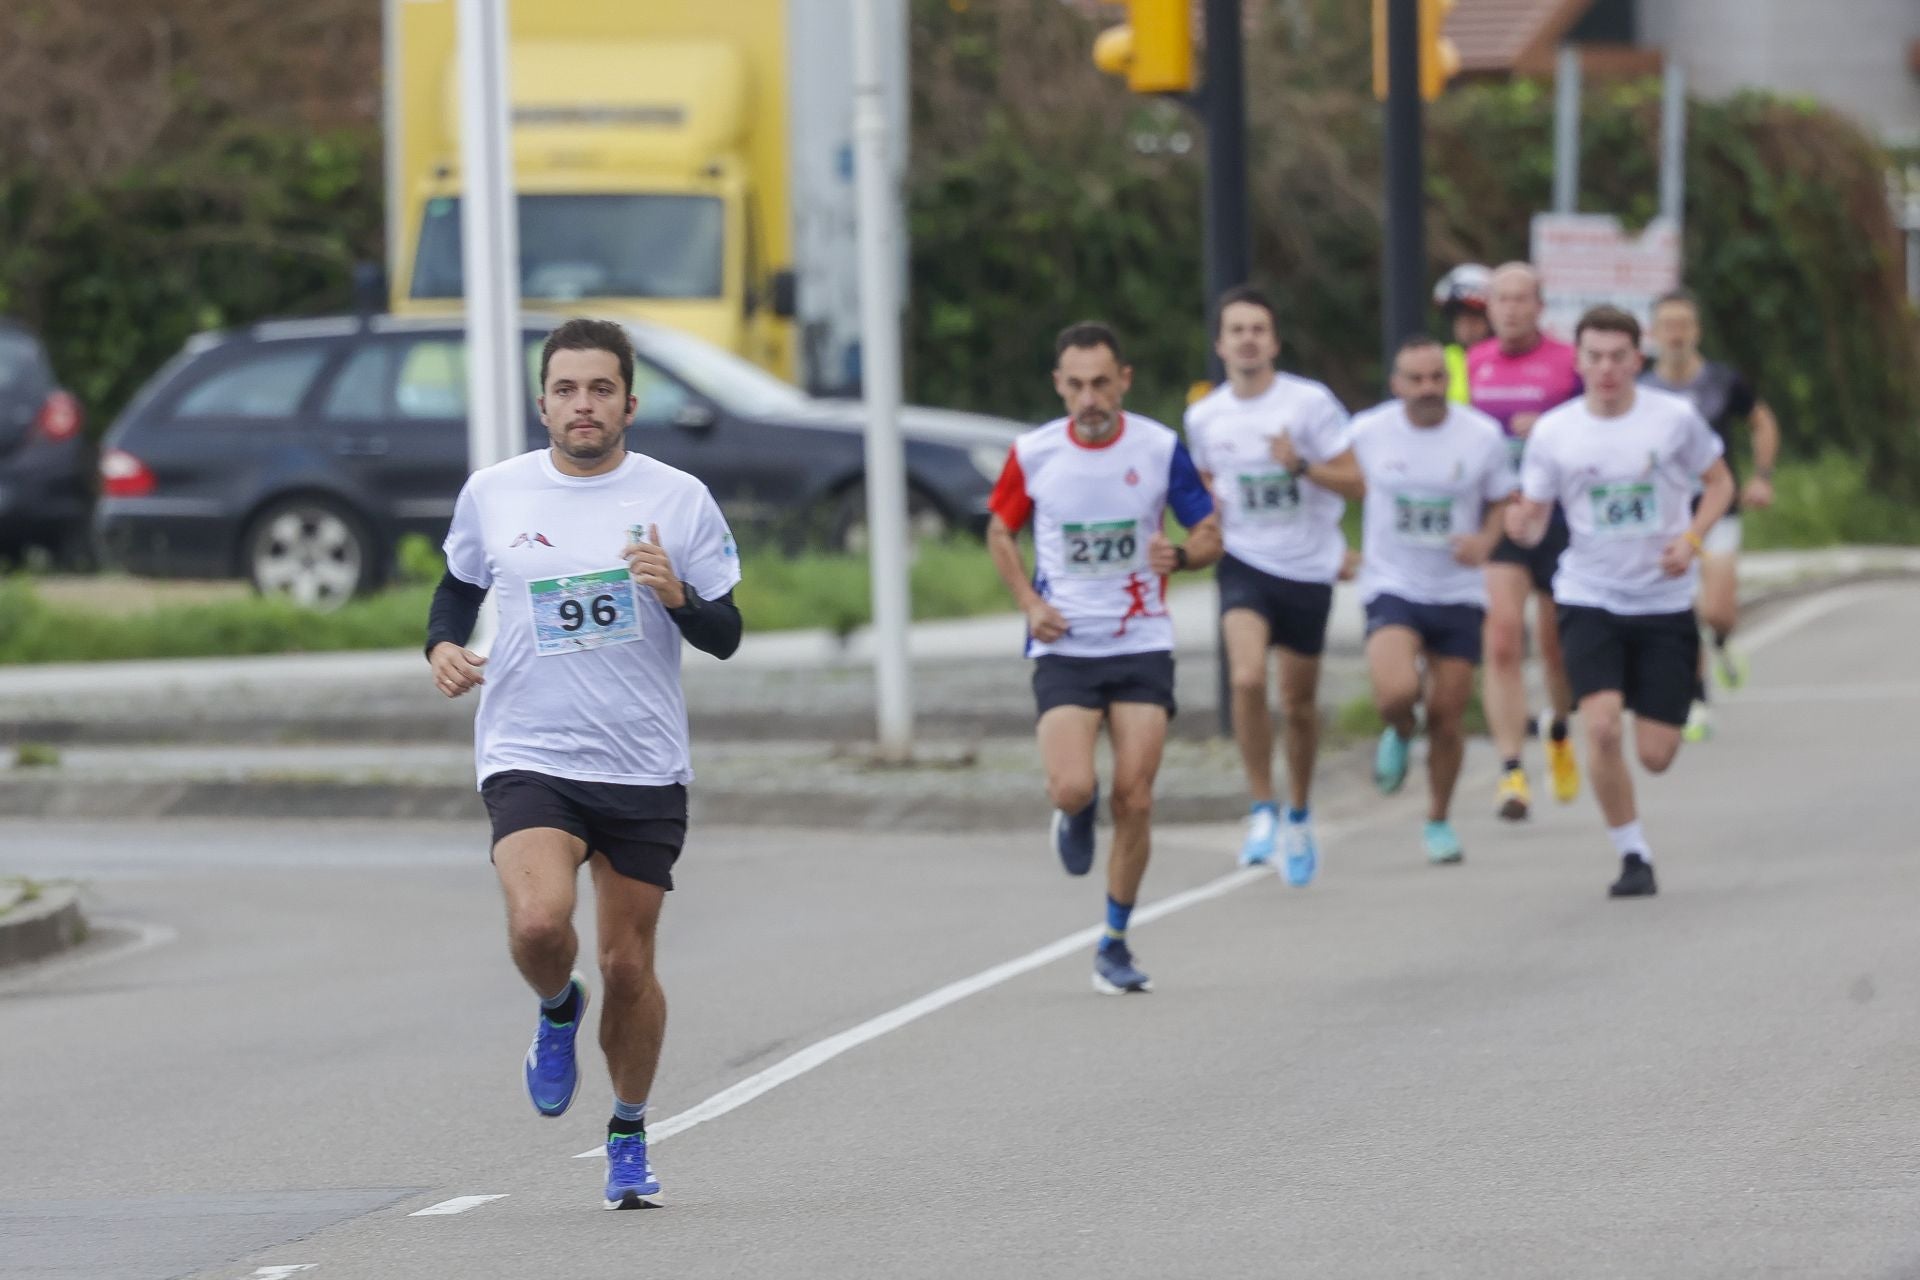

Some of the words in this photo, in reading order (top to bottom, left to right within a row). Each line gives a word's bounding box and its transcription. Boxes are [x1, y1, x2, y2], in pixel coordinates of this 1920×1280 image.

[1607, 498, 1644, 524] 64
[1071, 535, 1137, 562] 270
[559, 594, 616, 631] 96
